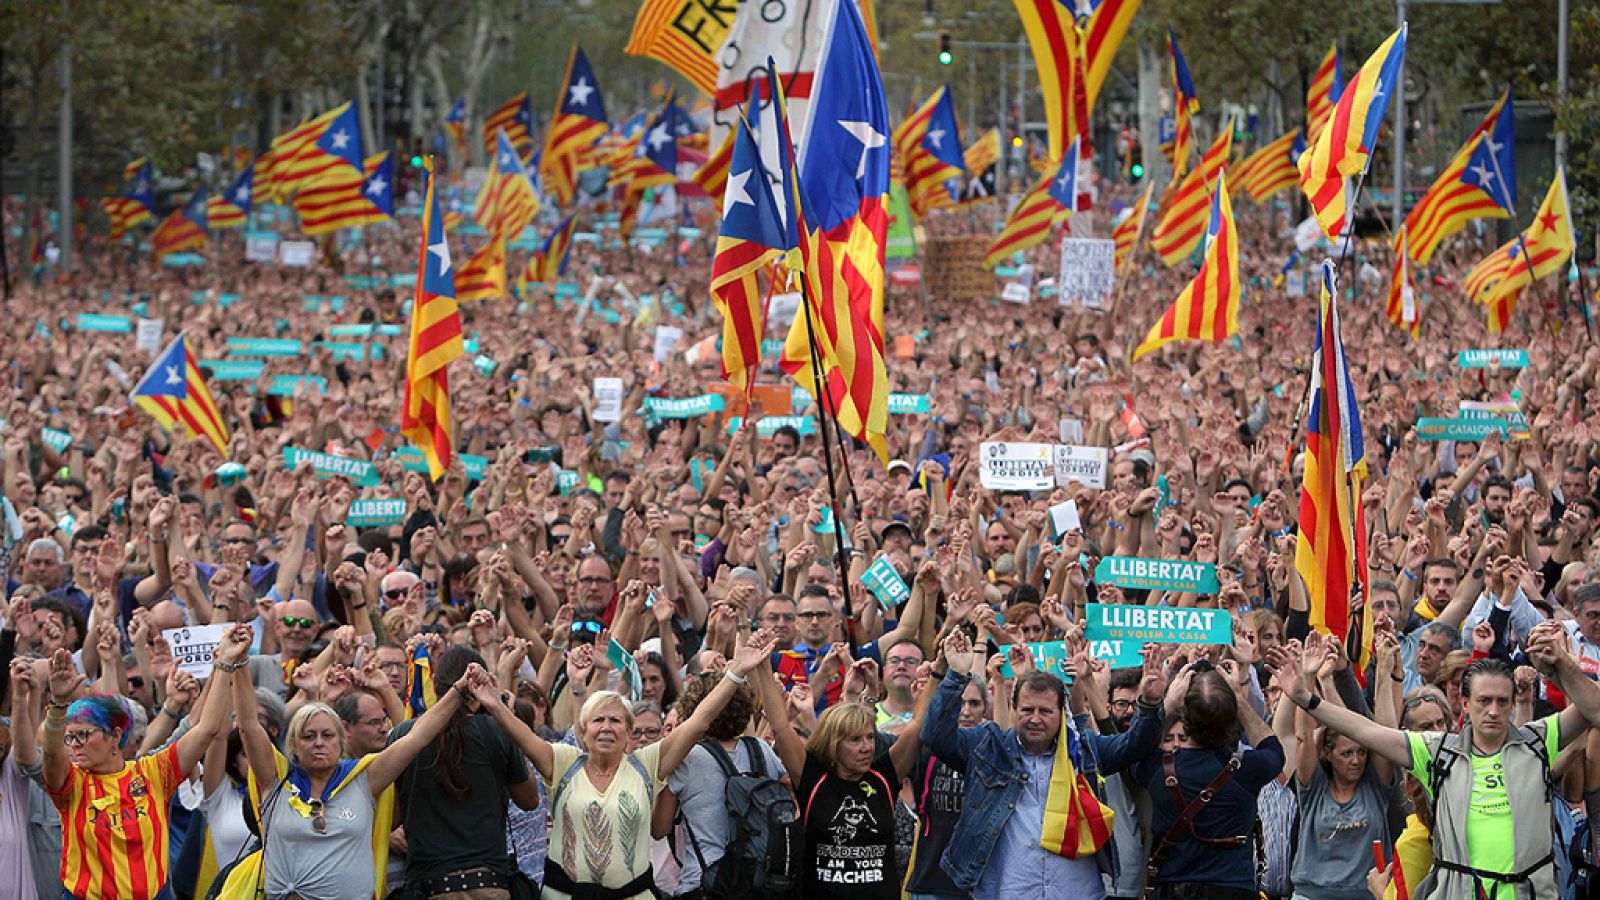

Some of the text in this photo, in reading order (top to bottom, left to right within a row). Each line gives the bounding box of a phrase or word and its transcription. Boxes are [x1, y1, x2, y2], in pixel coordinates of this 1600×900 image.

[1110, 558, 1205, 582] LLIBERTAT
[1102, 606, 1216, 631] LLIBERTAT
[1110, 629, 1208, 641] US VOLEM A CASA
[817, 844, 886, 859] STUDENTS
[827, 859, 845, 869] AM
[854, 859, 884, 869] YOUR
[816, 868, 884, 884] TEACHER
